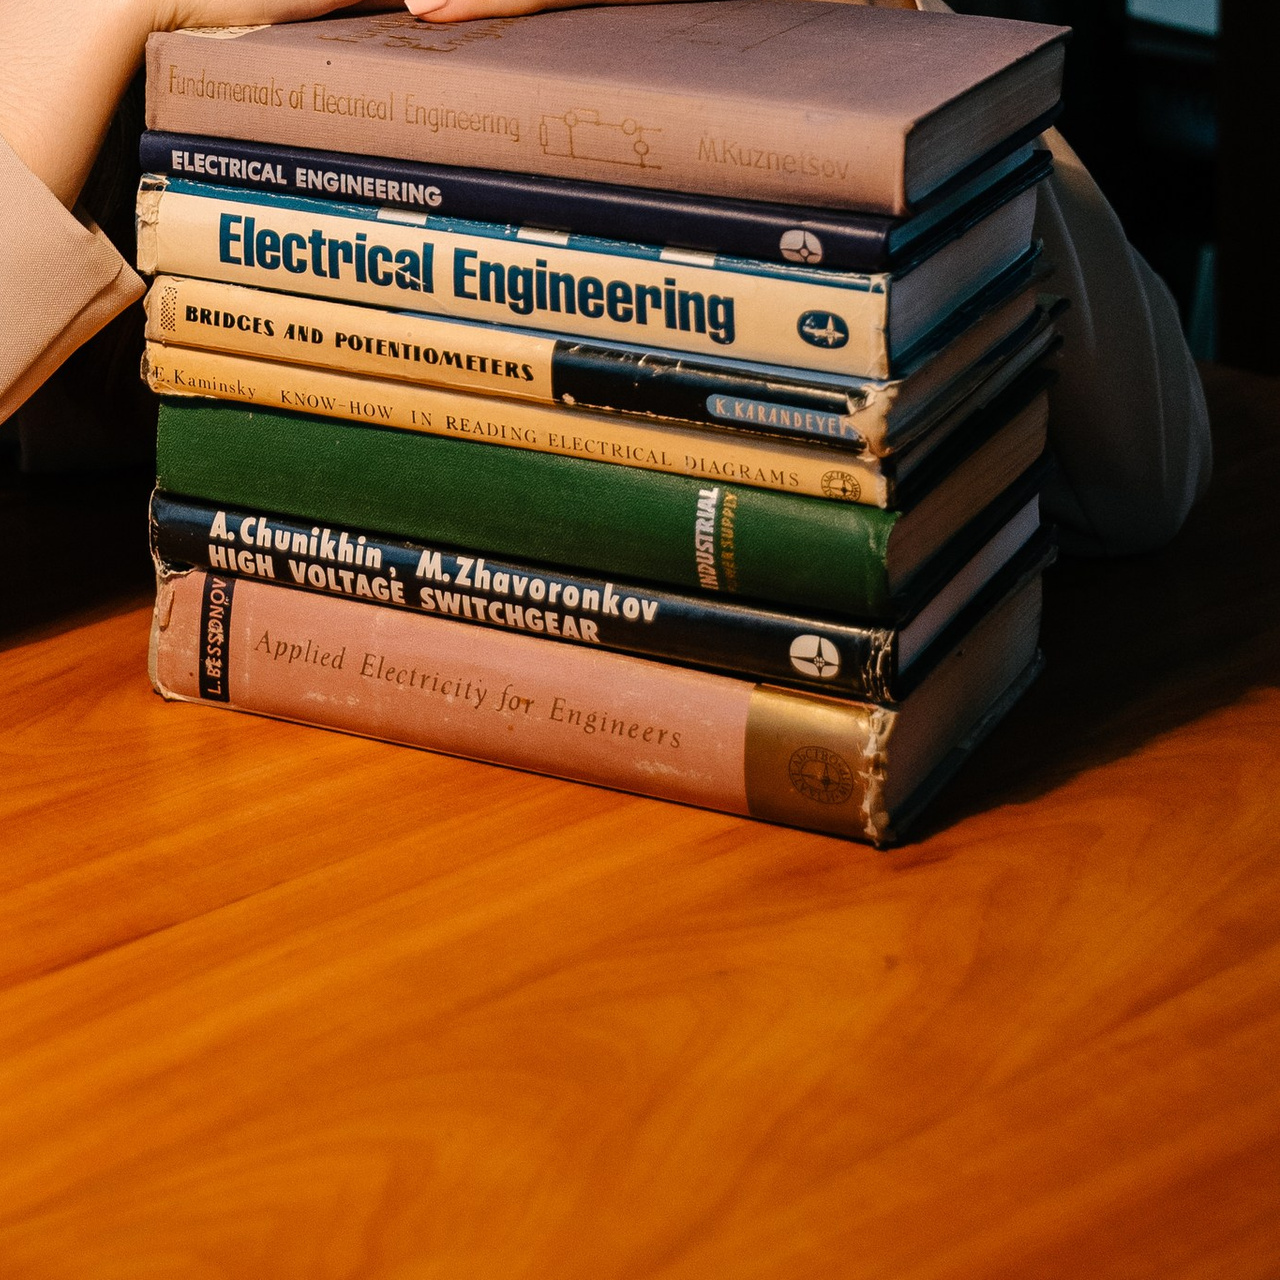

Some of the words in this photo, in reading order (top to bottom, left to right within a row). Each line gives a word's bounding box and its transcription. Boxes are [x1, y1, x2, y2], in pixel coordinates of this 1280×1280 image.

[168, 64, 283, 109] Fundamentals
[288, 83, 305, 111] of
[312, 83, 395, 122] Electrical
[404, 94, 521, 143] Engineering
[171, 149, 288, 185] ELECTRICAL
[295, 167, 443, 207] ENGINEERING
[219, 212, 435, 294] Electrical
[453, 248, 736, 346] Engineering
[184, 305, 276, 337] BRIDGES
[283, 323, 324, 345] AND
[334, 331, 535, 382] POTENTIOMETERS
[280, 389, 394, 420] KNOW-HOW
[411, 409, 434, 428] IN
[445, 414, 538, 445] READING
[548, 433, 673, 467] ELECTRICAL
[685, 454, 801, 488] DIAGRAMS
[695, 487, 719, 591] INDUSTRIAL
[720, 491, 738, 549] SUPPLY
[208, 543, 276, 579] HIGH
[288, 559, 407, 604] VOLTAGE
[419, 587, 601, 642] SWITCHGEAR
[253, 630, 346, 671] Applied
[359, 652, 488, 710] Electricity
[495, 683, 536, 716] for
[548, 696, 683, 750] Engineers
